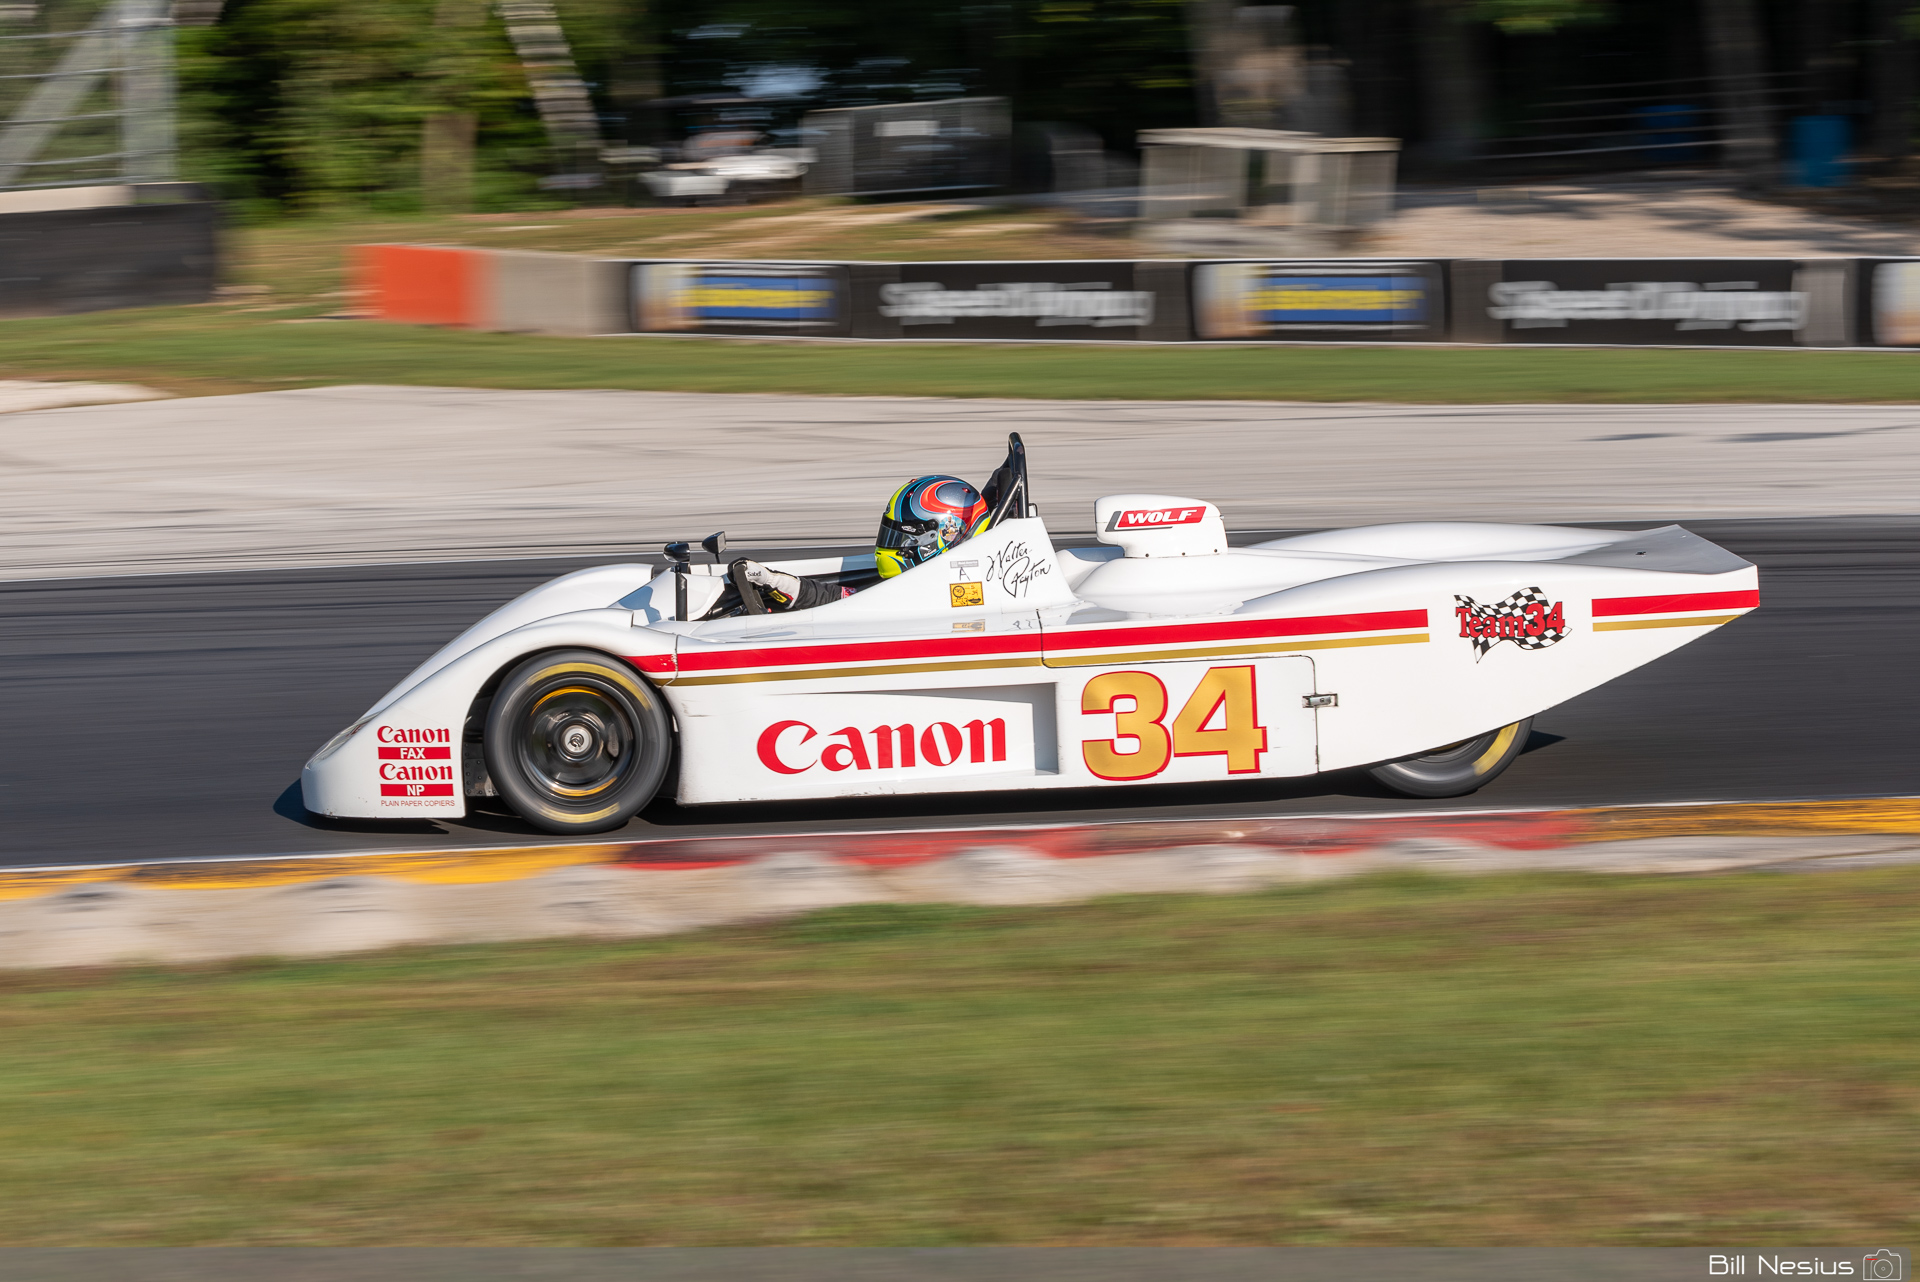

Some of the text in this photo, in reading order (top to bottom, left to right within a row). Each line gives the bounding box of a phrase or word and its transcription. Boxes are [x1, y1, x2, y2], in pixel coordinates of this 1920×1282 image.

[1127, 509, 1197, 524] WOLF
[1081, 664, 1268, 782] 34
[377, 725, 451, 743] Canon
[400, 748, 426, 759] FAX
[757, 717, 1007, 775] Canon
[379, 763, 453, 780] Canon
[406, 785, 425, 796] NP
